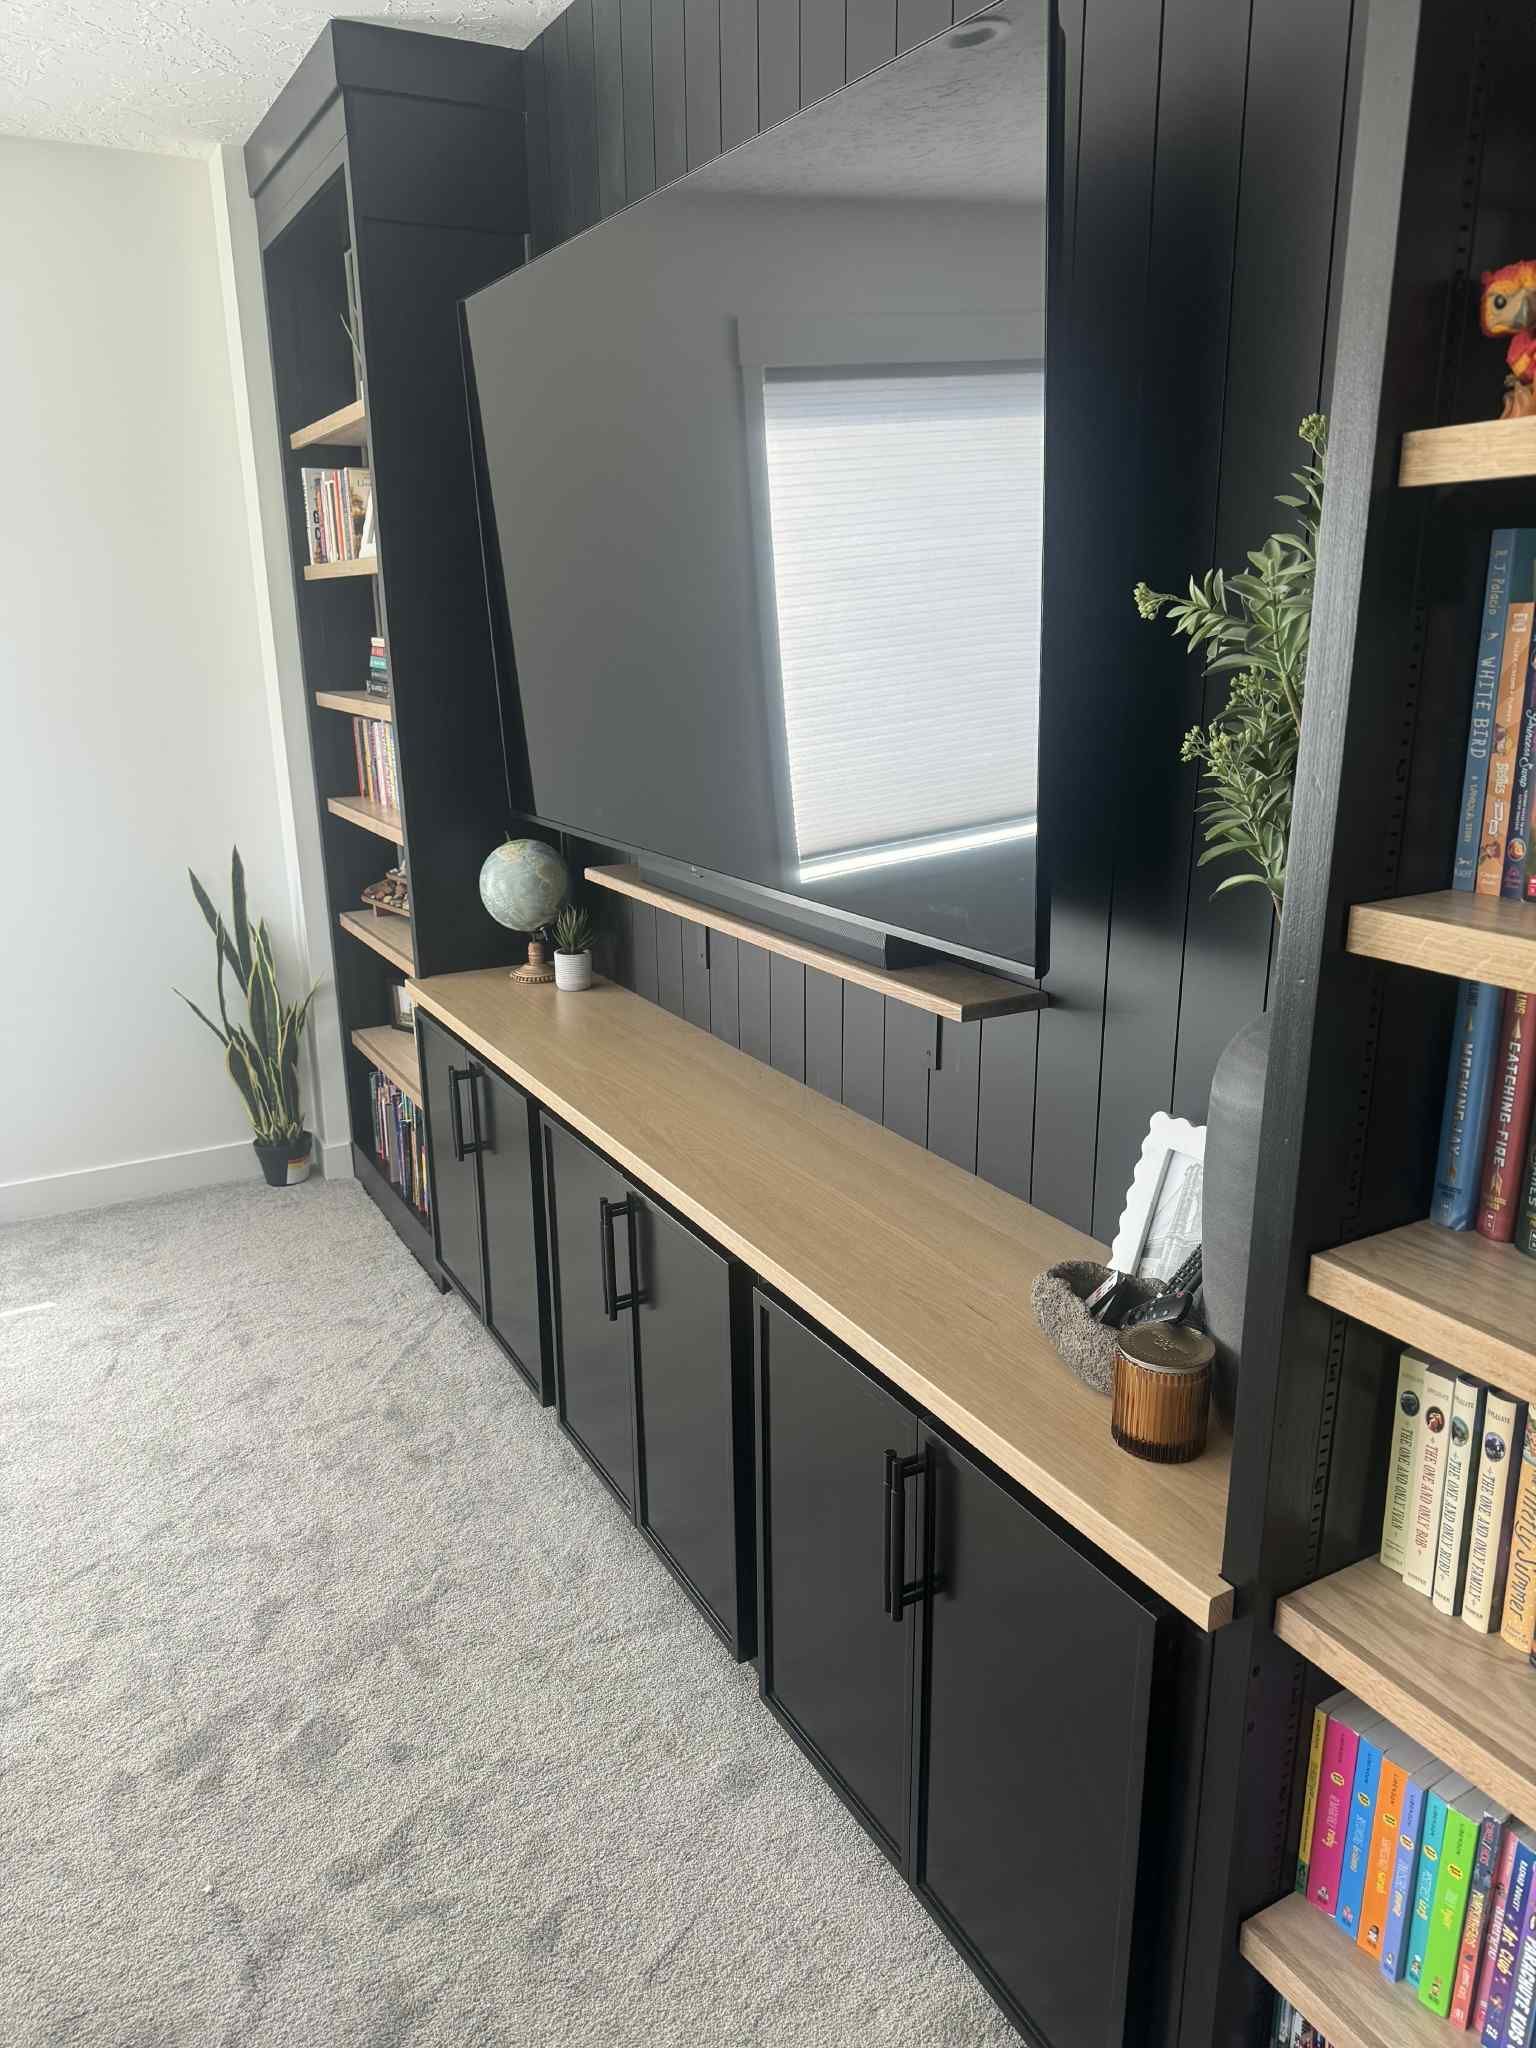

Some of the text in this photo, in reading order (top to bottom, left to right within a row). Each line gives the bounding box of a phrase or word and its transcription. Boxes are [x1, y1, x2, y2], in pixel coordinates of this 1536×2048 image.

[1488, 576, 1504, 615] Palacio
[1470, 656, 1496, 758] WHITE BIRD
[1494, 1041, 1521, 1168] CATCHING FIRE
[1400, 1427, 1414, 1447] THE
[1398, 1447, 1411, 1467] ONE
[1447, 1457, 1462, 1479] THE
[1396, 1464, 1409, 1485] AND
[1481, 1473, 1496, 1496] THE
[1393, 1485, 1408, 1508] ONLY
[1415, 1444, 1439, 1549] THE ONE AND ONLY BOB
[1446, 1479, 1460, 1501] ONE
[1442, 1502, 1457, 1523] AND
[1479, 1495, 1493, 1517] ONE
[1440, 1522, 1454, 1550] ONLY
[1475, 1515, 1490, 1538] AND
[1438, 1548, 1452, 1577] RUBY
[1472, 1538, 1488, 1565] ONLY
[1469, 1562, 1484, 1602] FAMILY
[1509, 1549, 1536, 1622] Summer
[1496, 1923, 1519, 1976] Art Club
[1508, 1935, 1536, 2046] PARACHUTE KIDS
